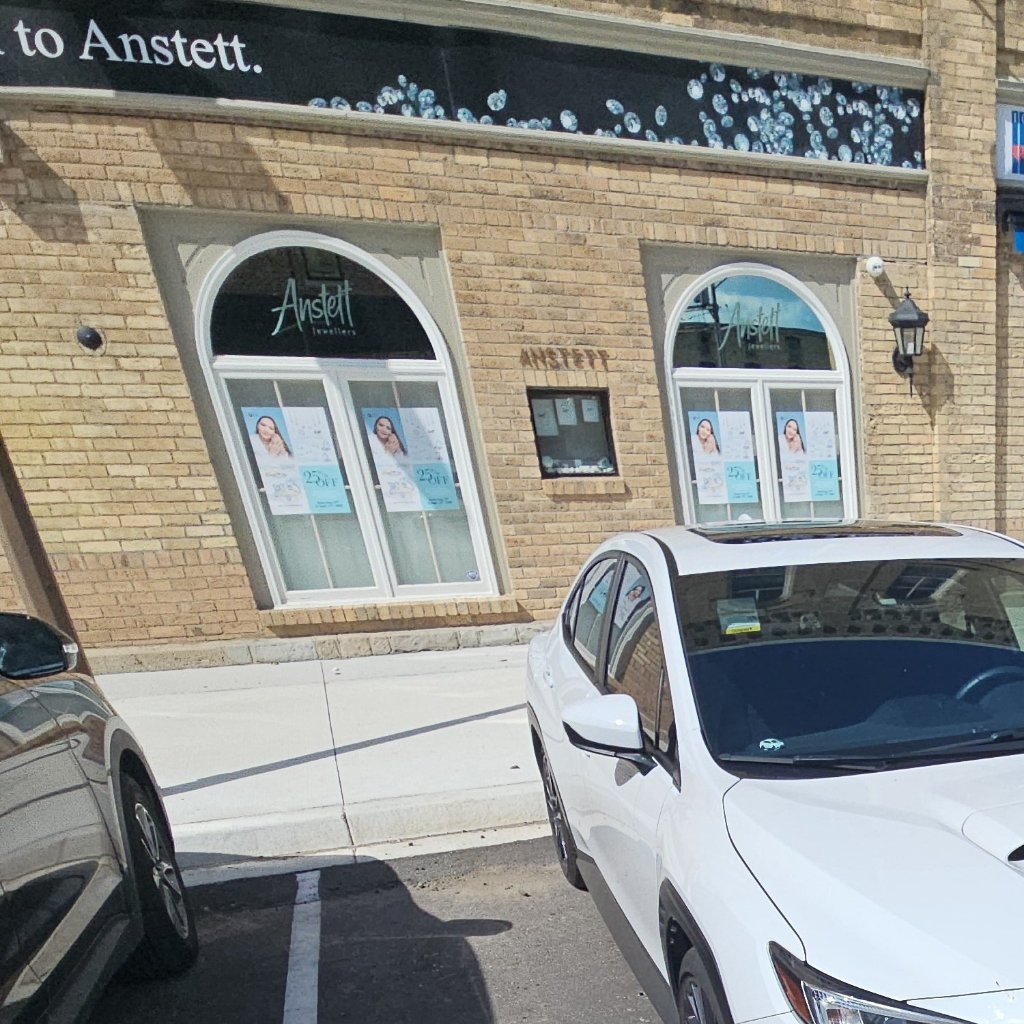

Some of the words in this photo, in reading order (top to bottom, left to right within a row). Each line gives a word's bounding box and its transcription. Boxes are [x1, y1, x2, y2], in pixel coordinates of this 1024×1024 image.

[13, 19, 64, 58] to
[79, 18, 263, 74] Anstett.
[271, 277, 354, 336] Anstett
[718, 302, 780, 350] Anstett
[520, 346, 610, 371] ANSTETT
